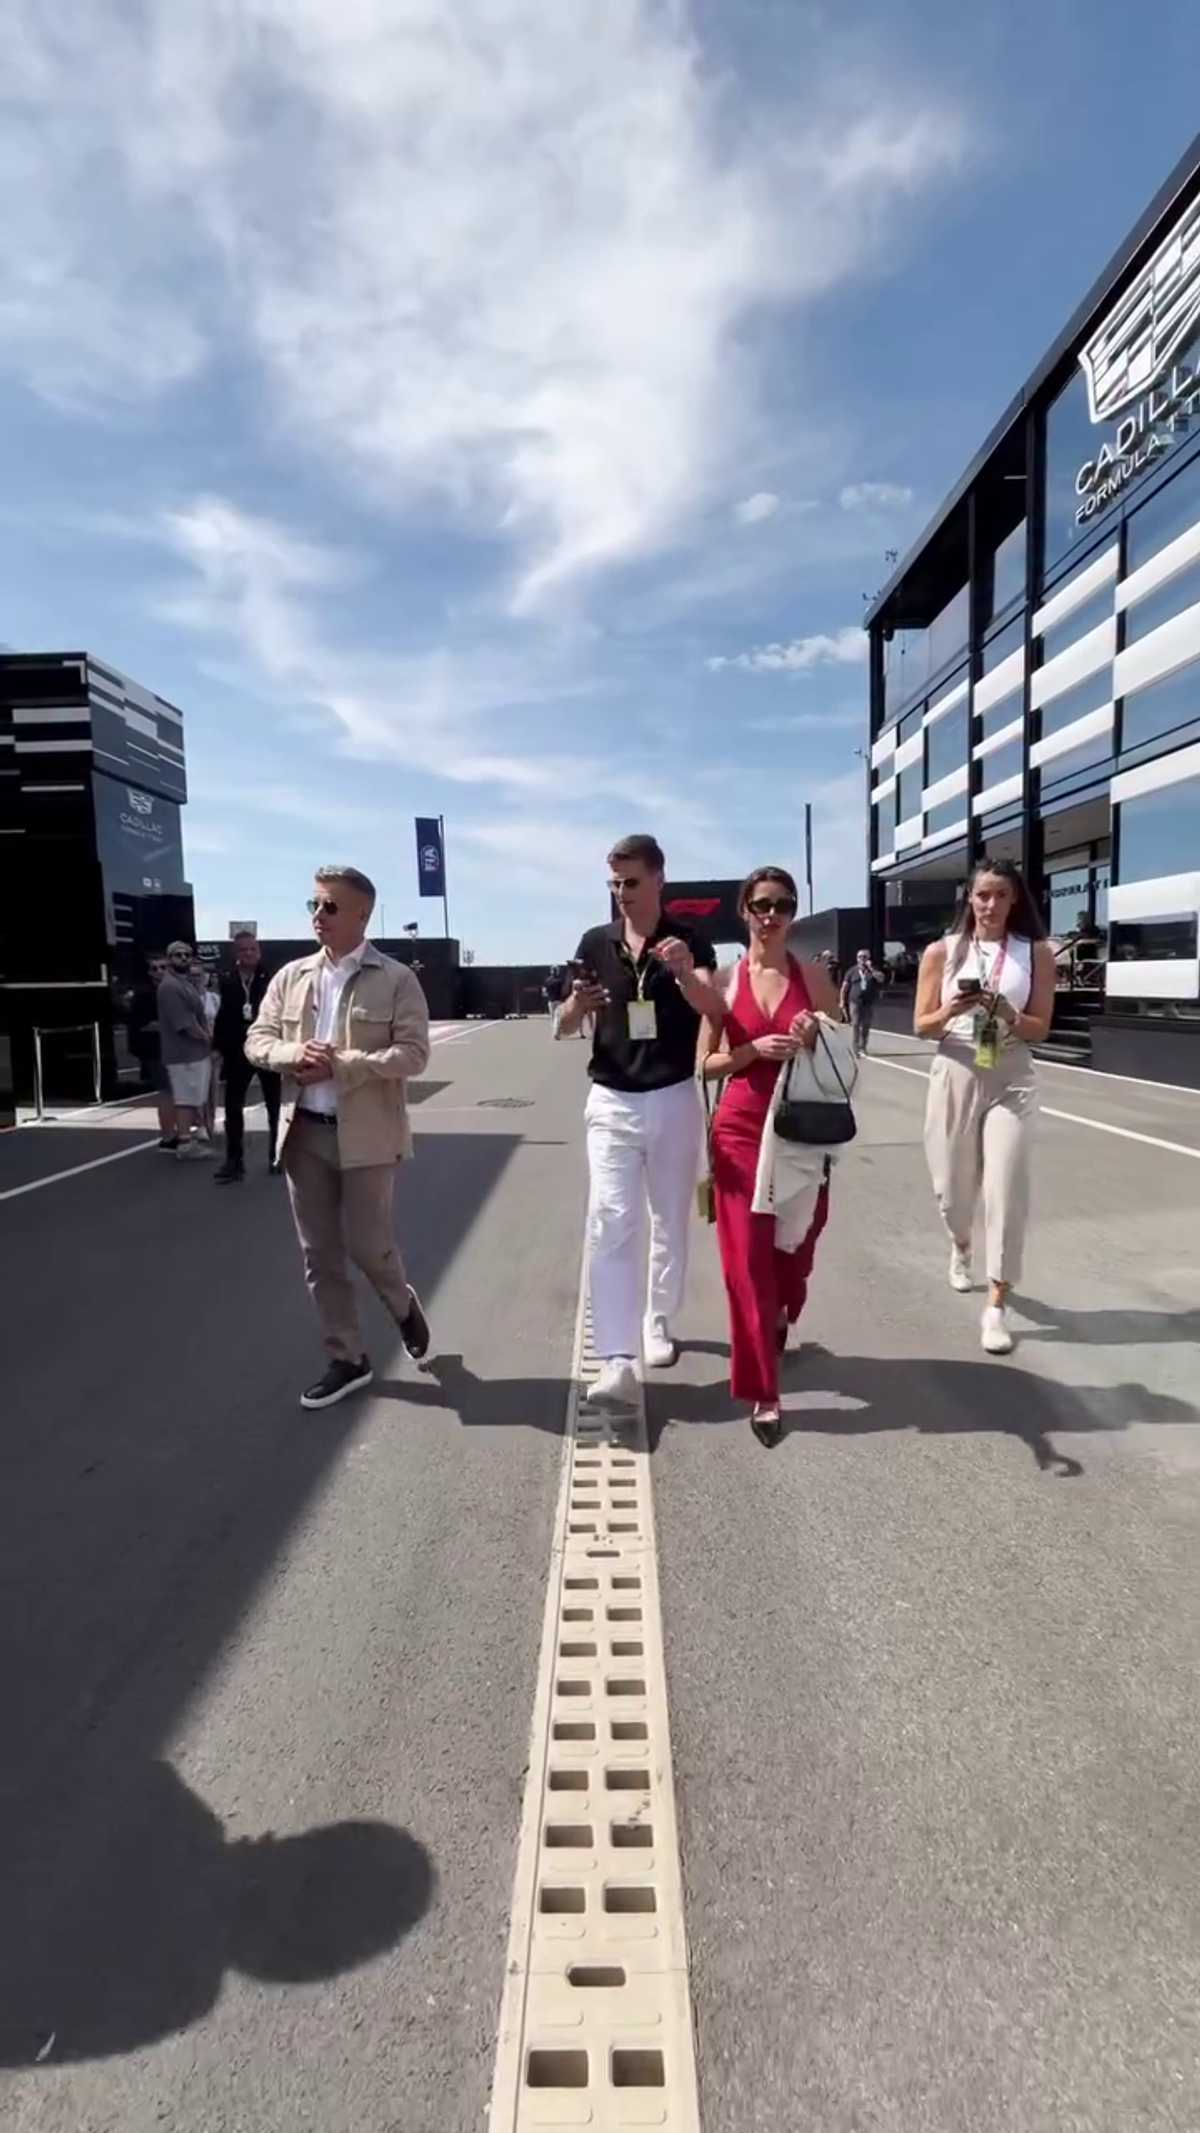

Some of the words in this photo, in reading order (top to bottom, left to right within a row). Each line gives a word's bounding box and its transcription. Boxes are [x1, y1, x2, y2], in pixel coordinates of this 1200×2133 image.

[1075, 357, 1200, 495] CADILL
[1075, 433, 1160, 527] FORMULA
[424, 848, 437, 872] FIA
